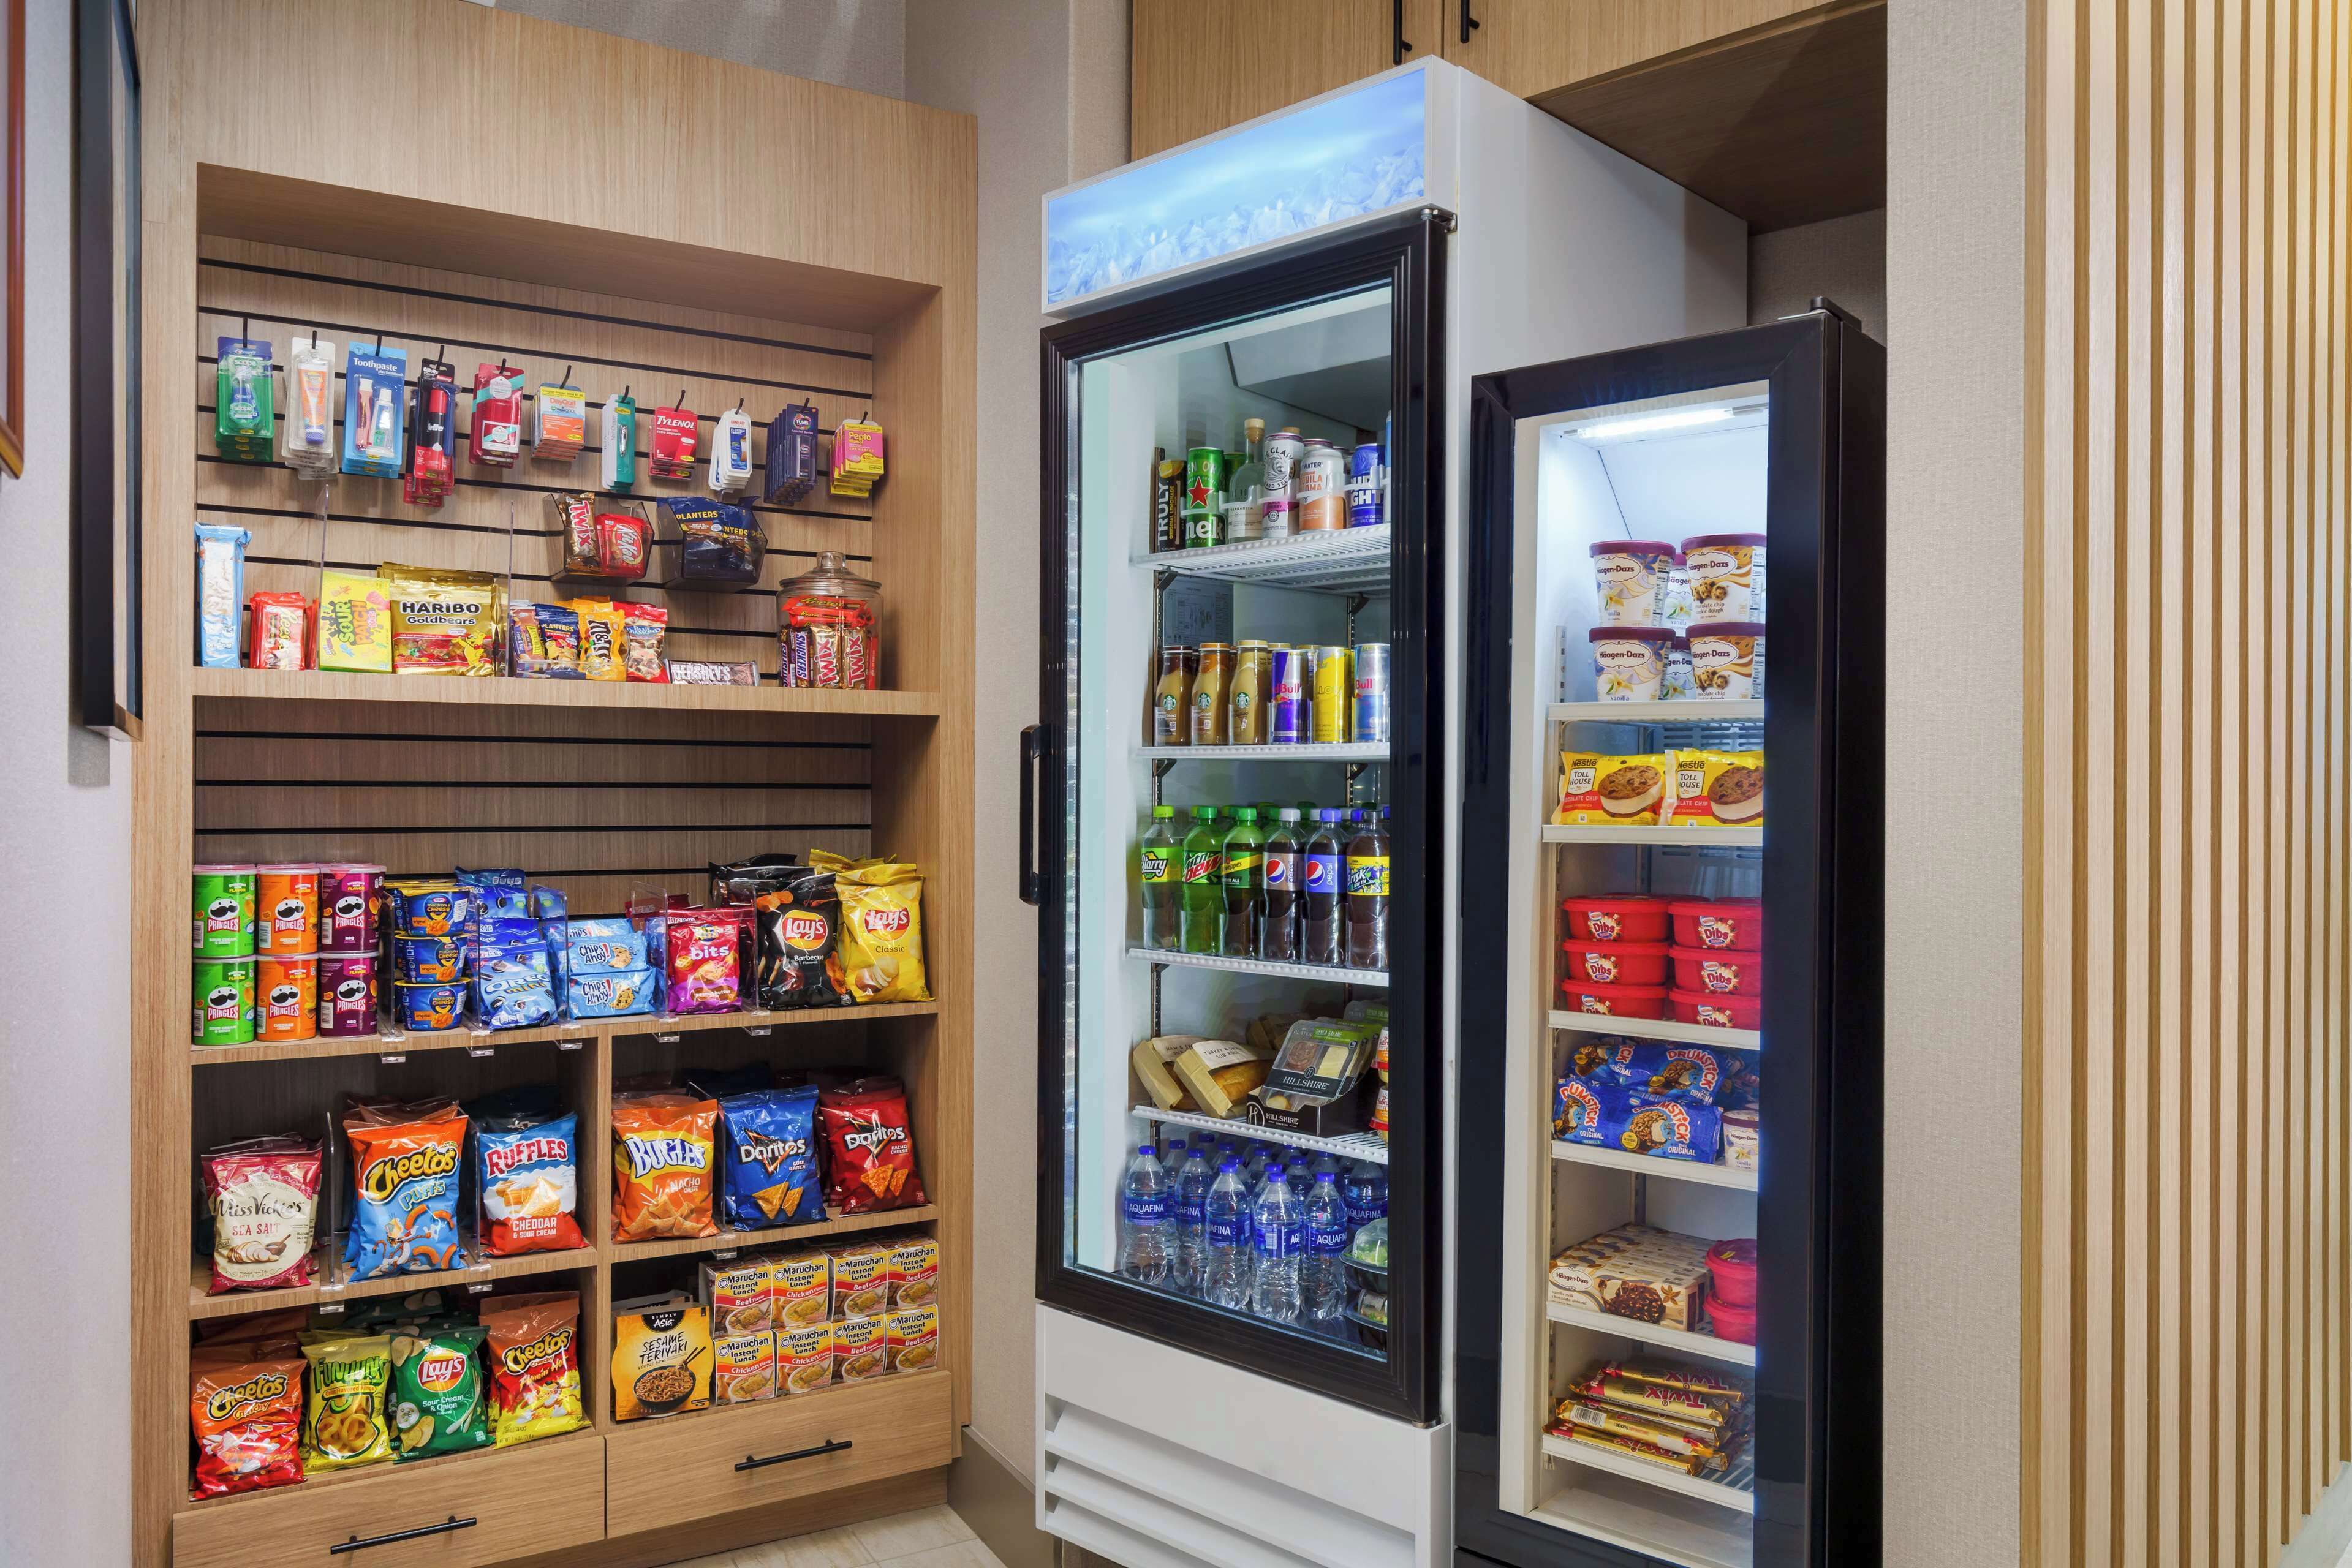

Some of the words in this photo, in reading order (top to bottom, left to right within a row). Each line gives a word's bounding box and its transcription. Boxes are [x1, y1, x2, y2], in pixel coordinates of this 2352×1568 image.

[354, 358, 397, 371] Toothpaste
[550, 397, 576, 407] DayQuil
[657, 415, 695, 429] TYLENOL
[849, 431, 871, 441] Pepto
[676, 510, 718, 521] PLANTERS
[1158, 483, 1168, 545] TRULY
[569, 499, 594, 549] Twix
[402, 602, 480, 614] HARIBO
[335, 601, 354, 643] SOUR
[407, 616, 475, 625] Goldbears
[796, 633, 807, 678] SNICKERS
[814, 638, 839, 685] Twix
[844, 635, 865, 686] Twix
[1599, 650, 1645, 660] Häagen-Dazs
[672, 664, 731, 680] HERSHEY'S
[1142, 854, 1167, 878] Starry
[208, 919, 238, 931] PRINGLES
[276, 919, 304, 932] PRINGLES
[336, 917, 364, 928] PRINGLES
[866, 908, 908, 932] Lay's
[785, 917, 825, 940] Lay's
[1593, 922, 1615, 934] Dibs
[1704, 927, 1728, 940] Dibs
[690, 944, 730, 960] bits
[1590, 964, 1612, 976] Dibs
[485, 975, 550, 993] OREO
[1707, 973, 1731, 986] Dibs
[505, 982, 546, 995] mini
[270, 1005, 299, 1017] PRINGLES
[337, 1000, 366, 1011] PRINGLES
[208, 1008, 238, 1019] PRINGLES
[1667, 1050, 1719, 1091] DRUMSTICK
[1283, 1077, 1328, 1090] HILLSHIRE
[1266, 1113, 1298, 1125] HILLSHIRE
[844, 1126, 906, 1149] Doritos
[485, 1138, 570, 1177] RUFFLES
[624, 1137, 705, 1178] BUGLES
[740, 1139, 806, 1164] Doritos
[1668, 1147, 1696, 1156] ORIGINAL
[365, 1144, 458, 1203] Cheetos
[670, 1177, 700, 1192] NACHO
[399, 1179, 446, 1212] PUFFS
[1129, 1204, 1163, 1214] AQUAFINA
[232, 1224, 252, 1236] SEA
[257, 1223, 280, 1234] SALT
[513, 1218, 557, 1231] CHEDDAR
[898, 1248, 935, 1259] Maruchan
[845, 1257, 883, 1268] Maruchan
[901, 1257, 926, 1266] Instant
[784, 1265, 824, 1275] Maruchan
[849, 1266, 875, 1275] Instant
[727, 1272, 768, 1283] Maruchan
[1556, 1272, 1589, 1284] Häagen-Dazs
[730, 1281, 758, 1290] Instant
[786, 1288, 814, 1297] Chicken
[654, 1319, 673, 1328] Asia
[897, 1313, 934, 1324] Maruchan
[843, 1321, 881, 1332] Maruchan
[789, 1330, 828, 1342] Maruchan
[846, 1330, 872, 1339] Instant
[643, 1332, 685, 1352] SESAME
[727, 1338, 768, 1351] Maruchan
[792, 1340, 819, 1349] Instant
[502, 1329, 572, 1374] Cheetos
[640, 1341, 687, 1364] TERIYAKI
[731, 1348, 759, 1357] Instant
[530, 1356, 552, 1367] Crunchy
[792, 1355, 819, 1364] Chicken
[314, 1356, 389, 1393] FUNYUNS
[422, 1357, 463, 1382] Lay's
[732, 1363, 759, 1373] Chicken
[1665, 1371, 1729, 1391] Twix
[208, 1373, 288, 1421] Cheetos
[422, 1399, 440, 1408] Sour
[1645, 1385, 1707, 1409] Twix
[233, 1402, 270, 1420] Crunchy
